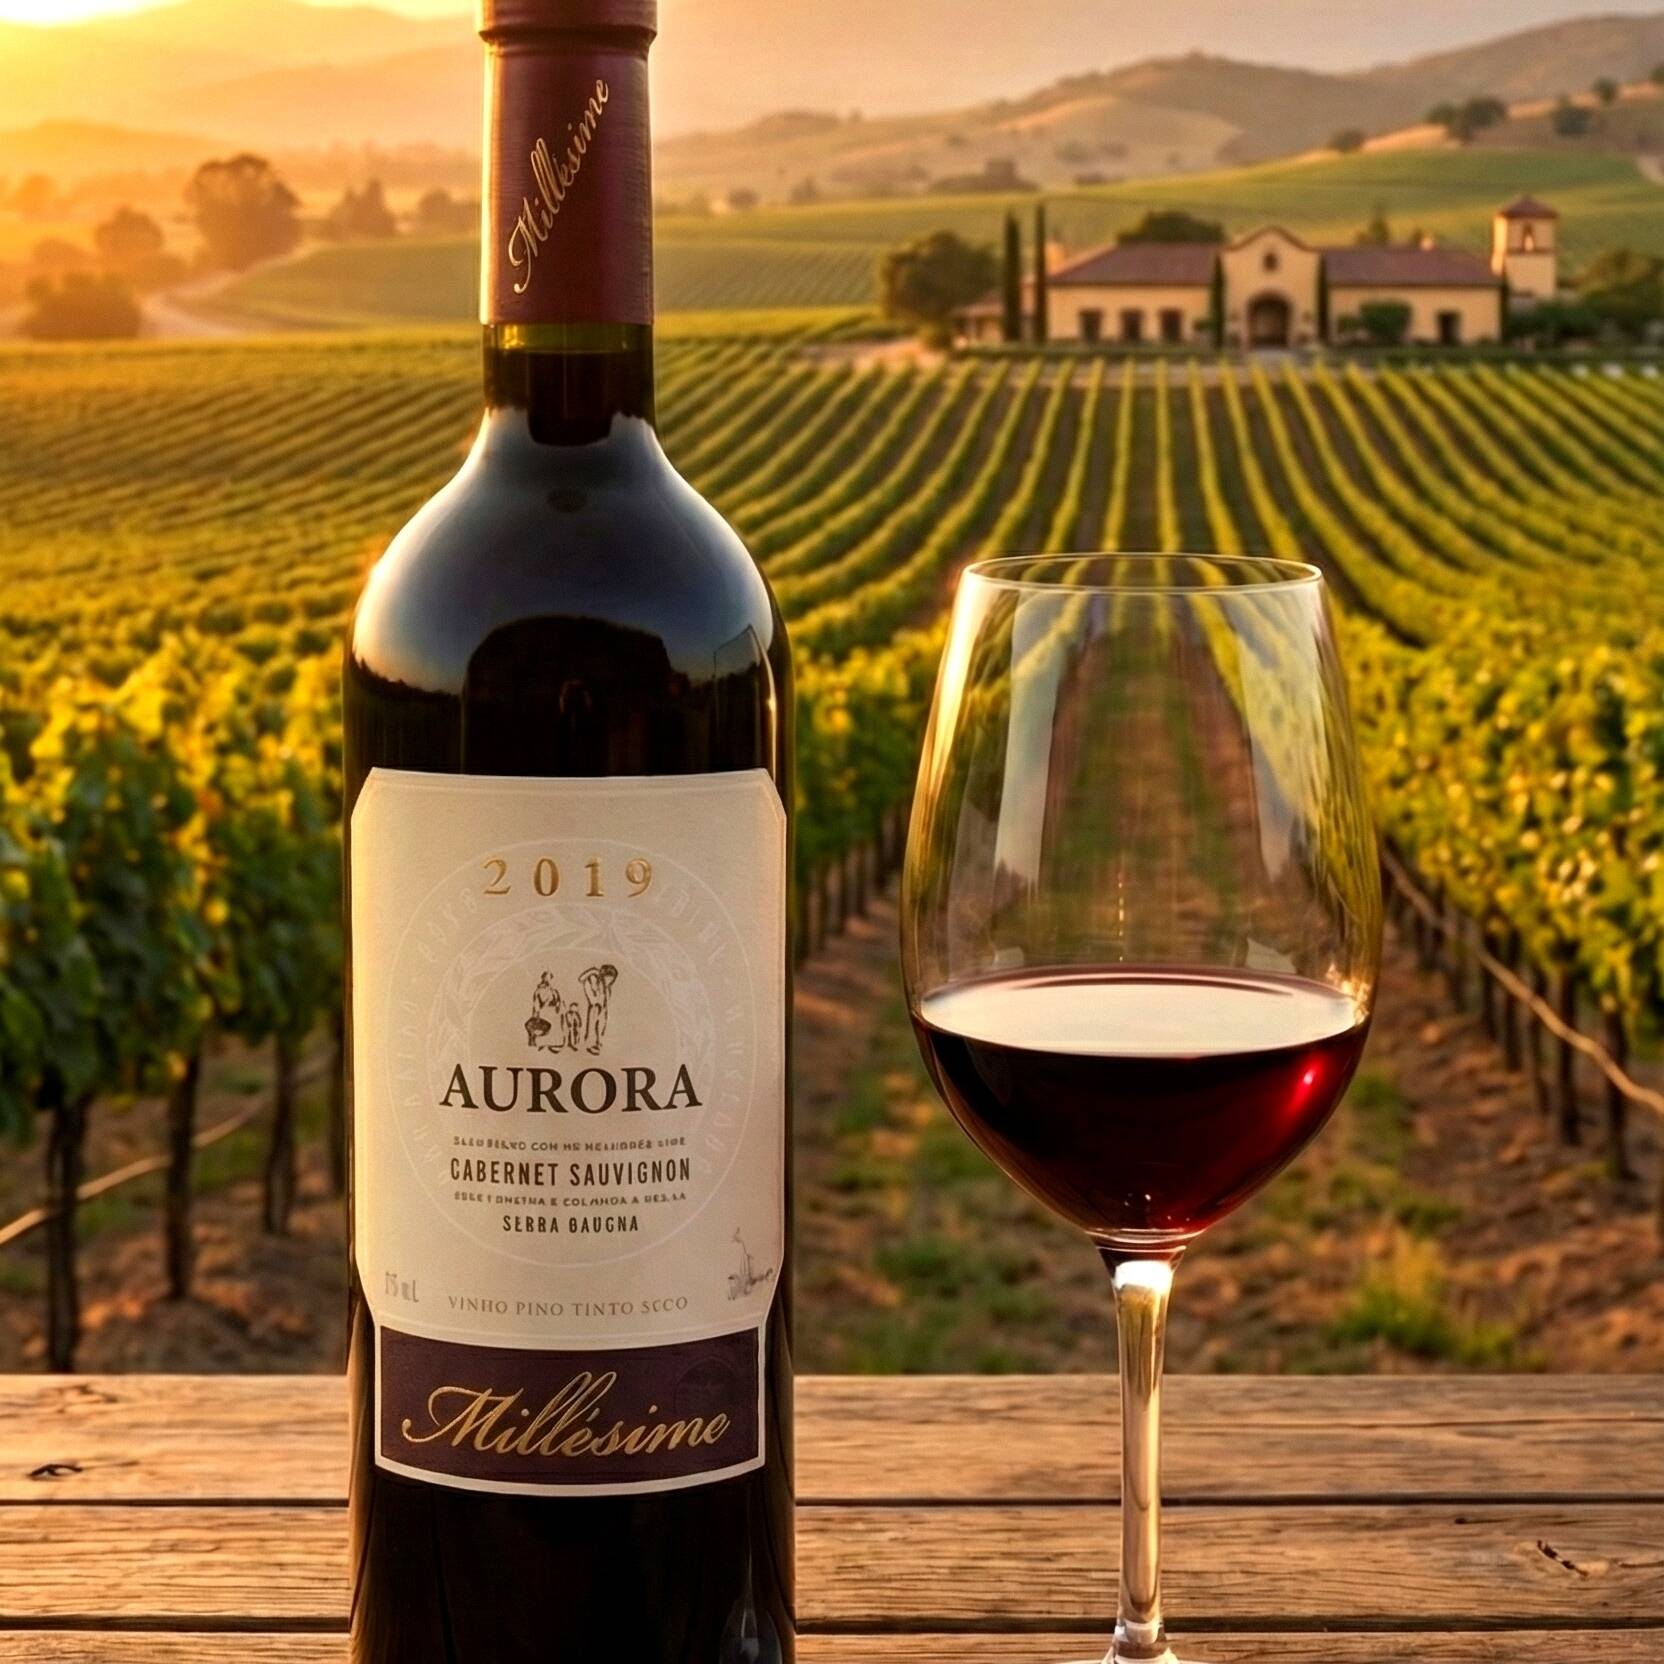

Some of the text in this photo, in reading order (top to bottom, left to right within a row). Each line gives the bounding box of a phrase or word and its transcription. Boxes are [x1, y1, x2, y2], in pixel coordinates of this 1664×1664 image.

[482, 857, 653, 898] 2019
[438, 1063, 703, 1114] AURORA
[450, 1157, 690, 1187] CABERNET SAUVIGNON
[447, 1295, 508, 1315] VINHO
[515, 1301, 564, 1317] PINO
[572, 1301, 634, 1317] TINTO
[402, 1371, 731, 1457] Millésime
